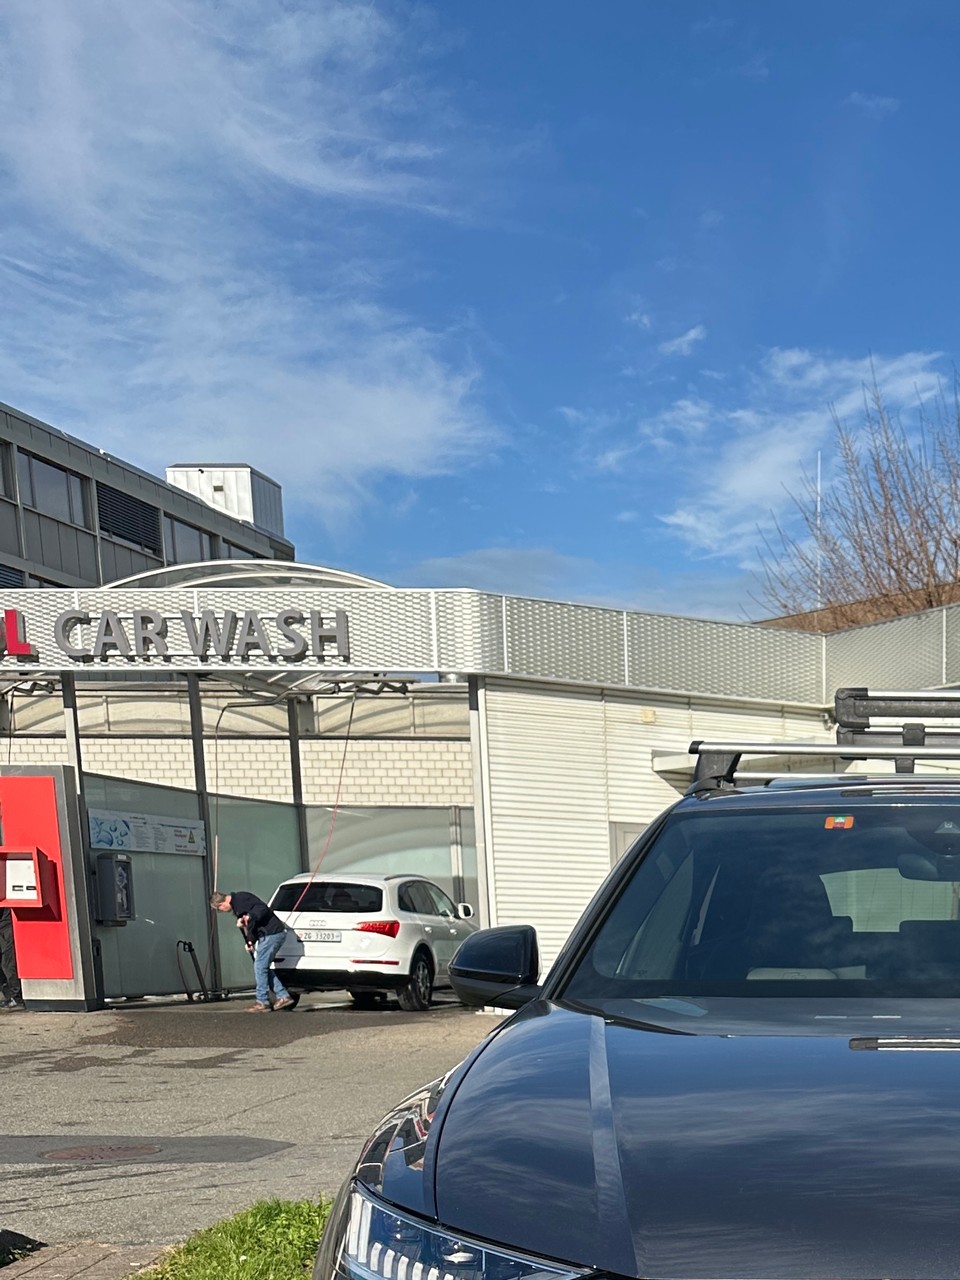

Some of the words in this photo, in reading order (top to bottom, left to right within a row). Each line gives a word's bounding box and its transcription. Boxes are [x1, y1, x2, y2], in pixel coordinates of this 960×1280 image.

[0, 608, 33, 656] L
[54, 608, 168, 657] CAR
[180, 608, 349, 658] WASH
